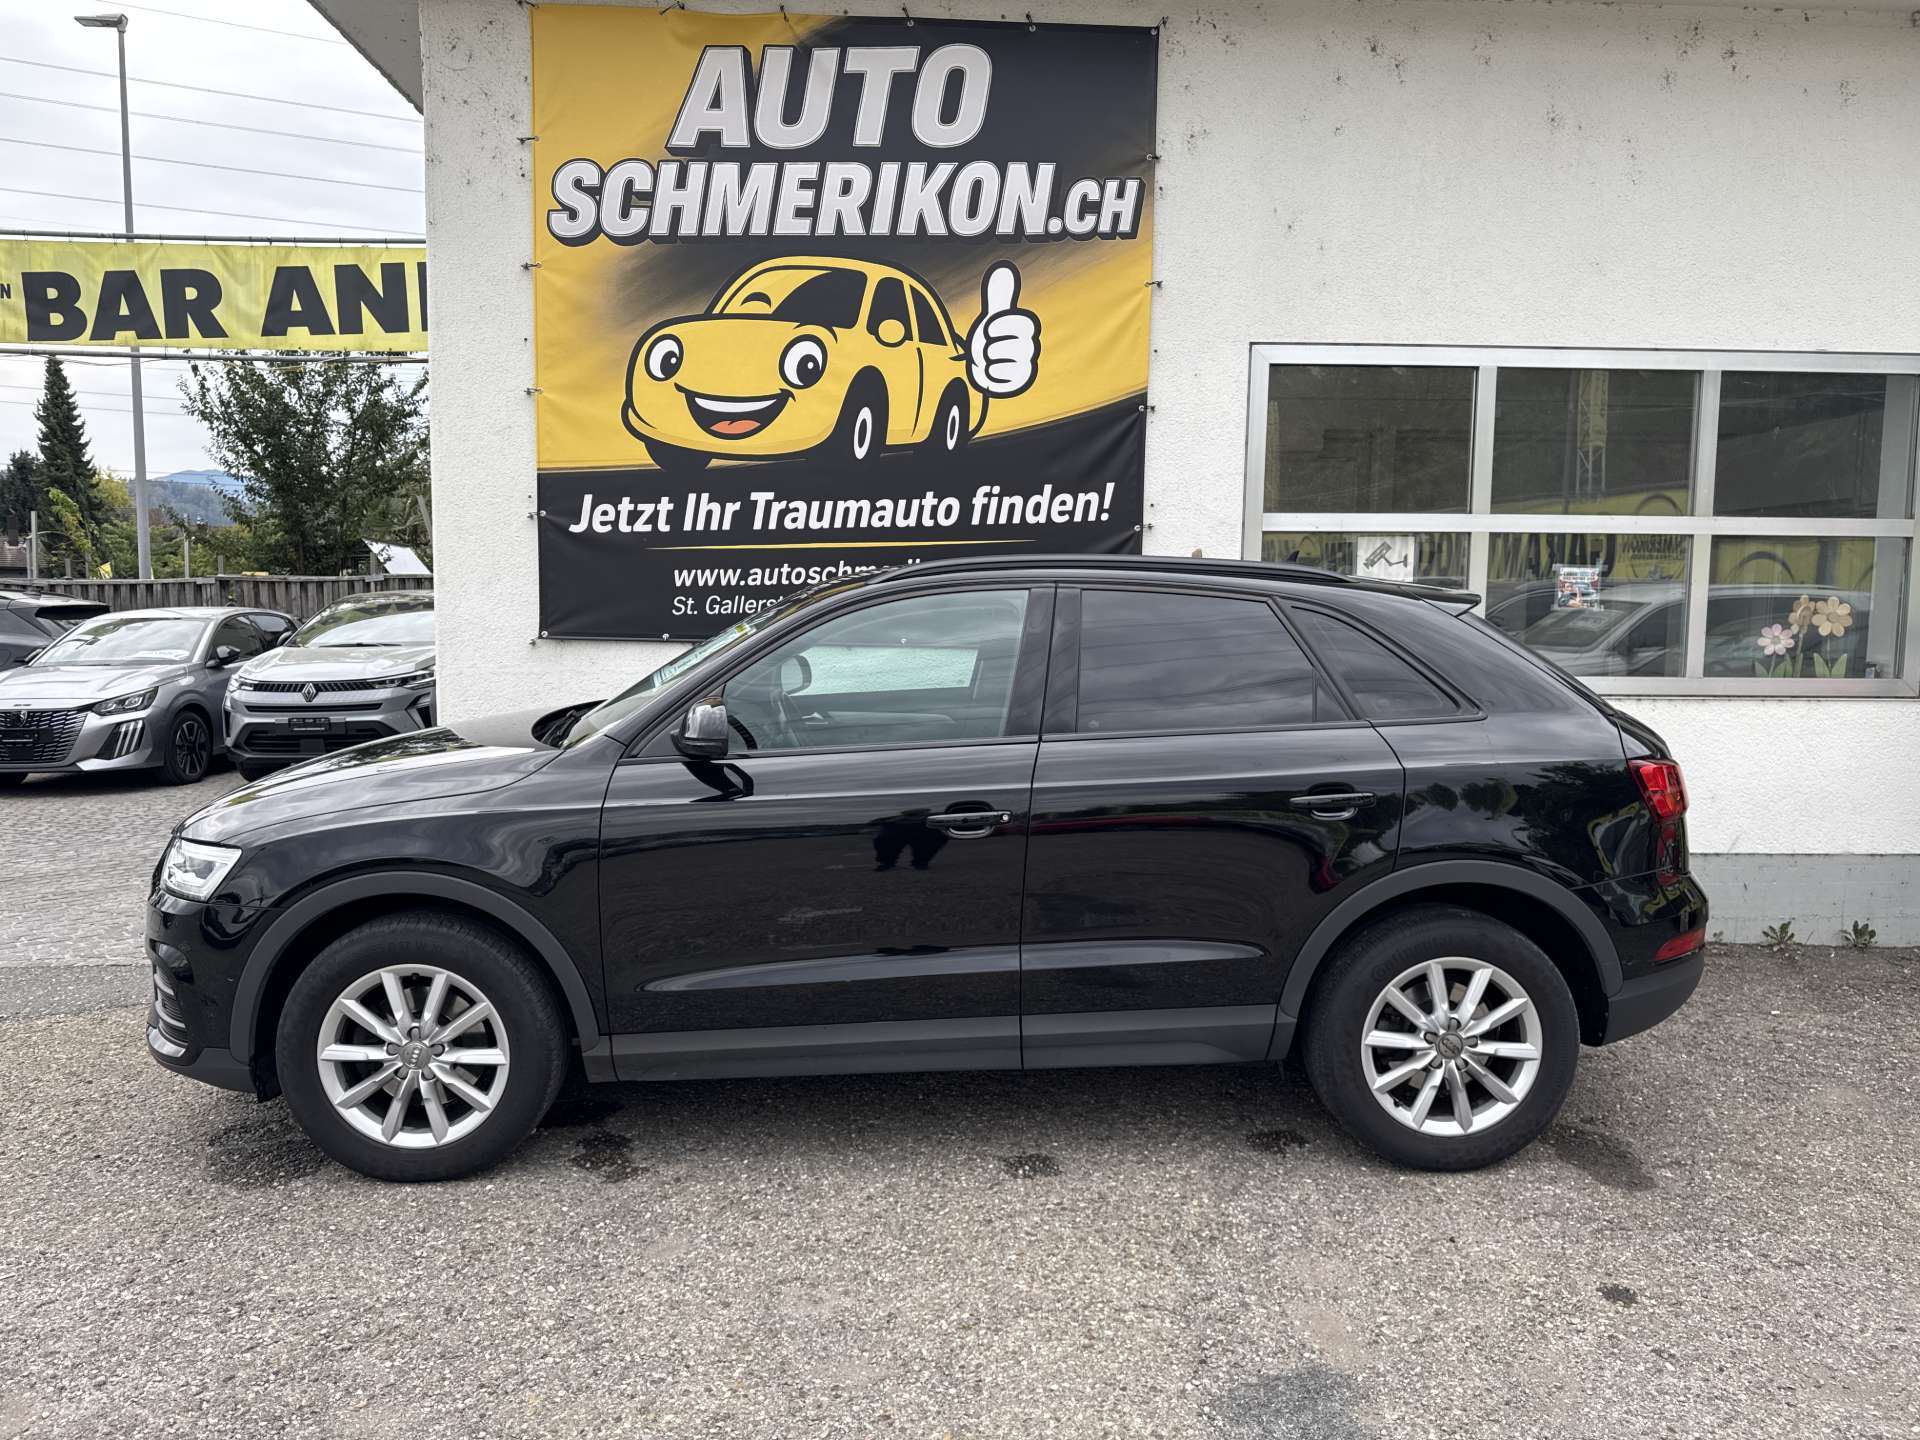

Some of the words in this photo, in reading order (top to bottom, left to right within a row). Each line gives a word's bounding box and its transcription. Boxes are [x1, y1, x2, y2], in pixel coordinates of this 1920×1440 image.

[668, 43, 993, 150] AUTO
[548, 157, 1140, 238] SCHMERIKON.CH
[21, 268, 229, 341] BAR
[568, 493, 674, 533] Jetzt
[683, 493, 741, 532] Ihr
[750, 491, 961, 531] Traumauto
[971, 482, 1116, 526] finden!
[672, 596, 698, 616] St.
